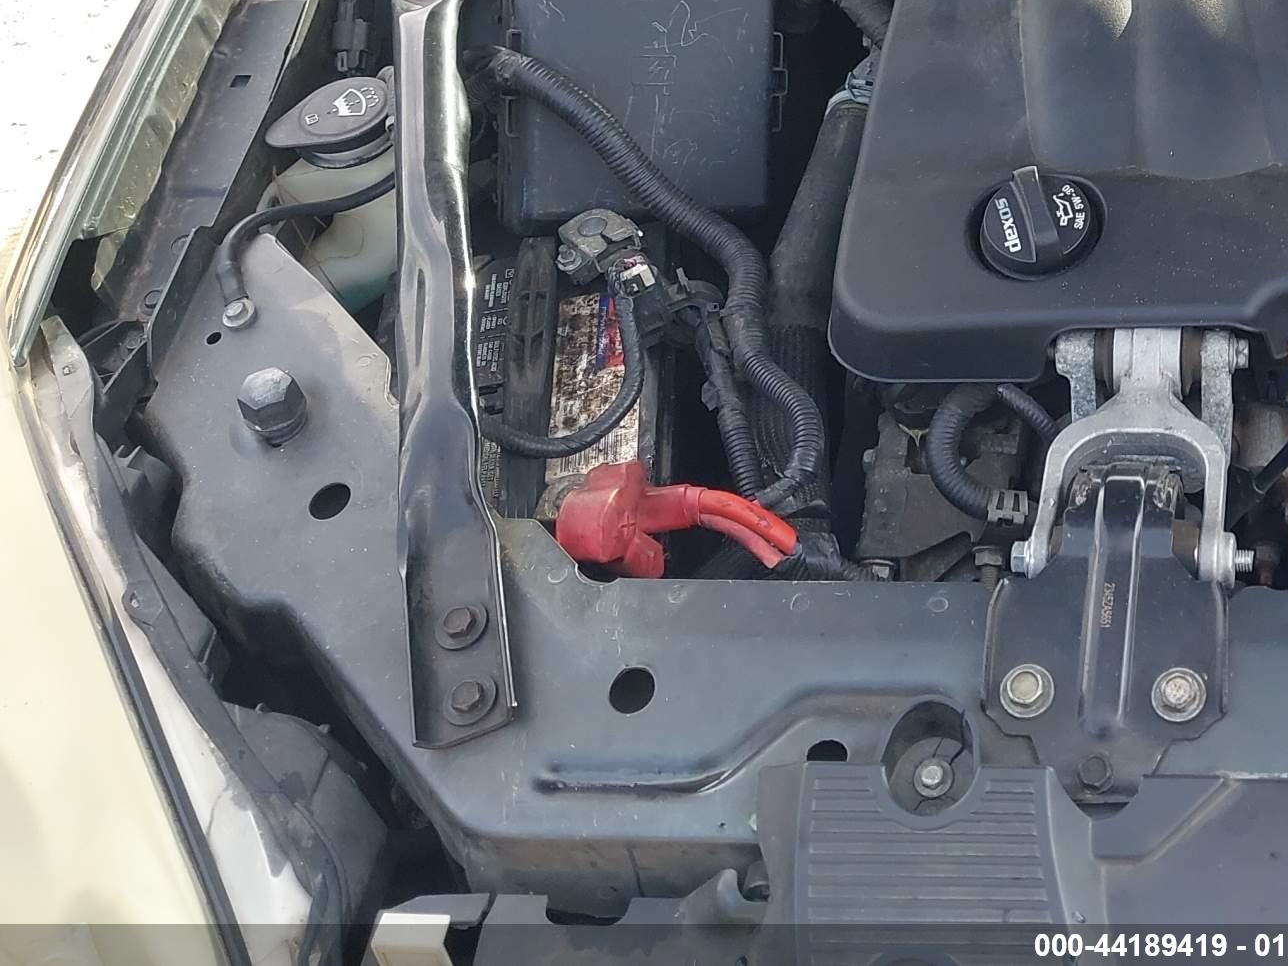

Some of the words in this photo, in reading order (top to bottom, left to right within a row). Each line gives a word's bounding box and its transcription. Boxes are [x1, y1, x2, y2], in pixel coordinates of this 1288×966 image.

[1062, 184, 1085, 210] 5W-30
[995, 197, 1022, 253] dexos
[1073, 212, 1086, 230] SAE
